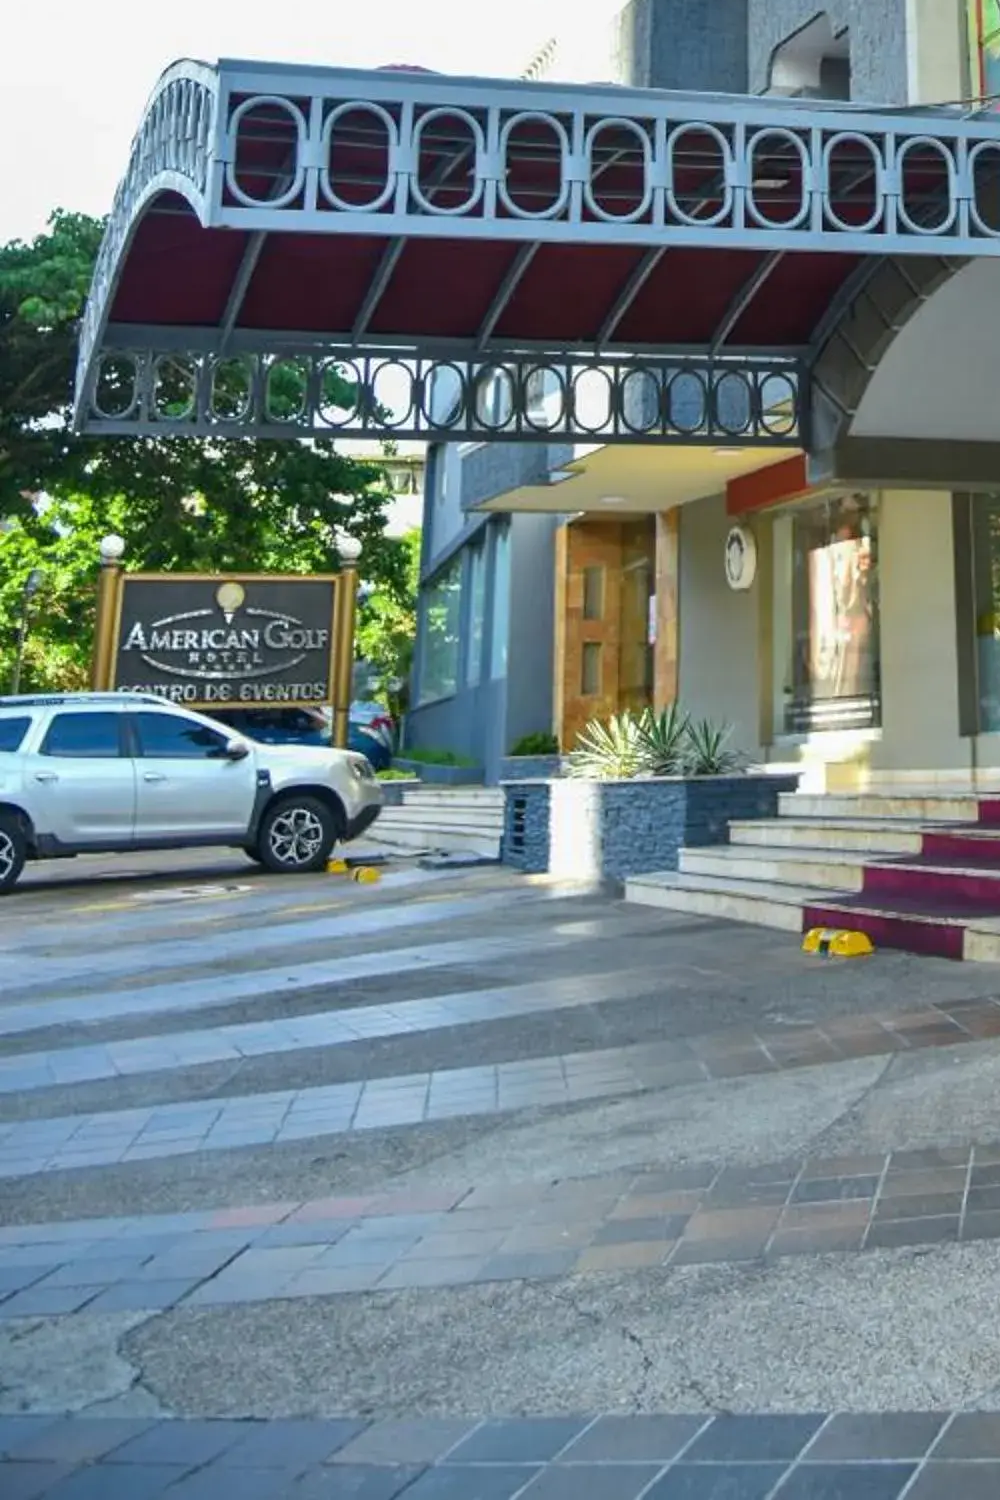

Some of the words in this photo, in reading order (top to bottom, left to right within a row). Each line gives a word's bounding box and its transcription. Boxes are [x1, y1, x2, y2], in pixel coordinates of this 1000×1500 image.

[122, 621, 260, 650] AMERICAN
[263, 620, 329, 649] GOLF
[188, 651, 263, 664] HOTEL
[204, 683, 232, 701] DE
[240, 682, 327, 701] EVENTOS
